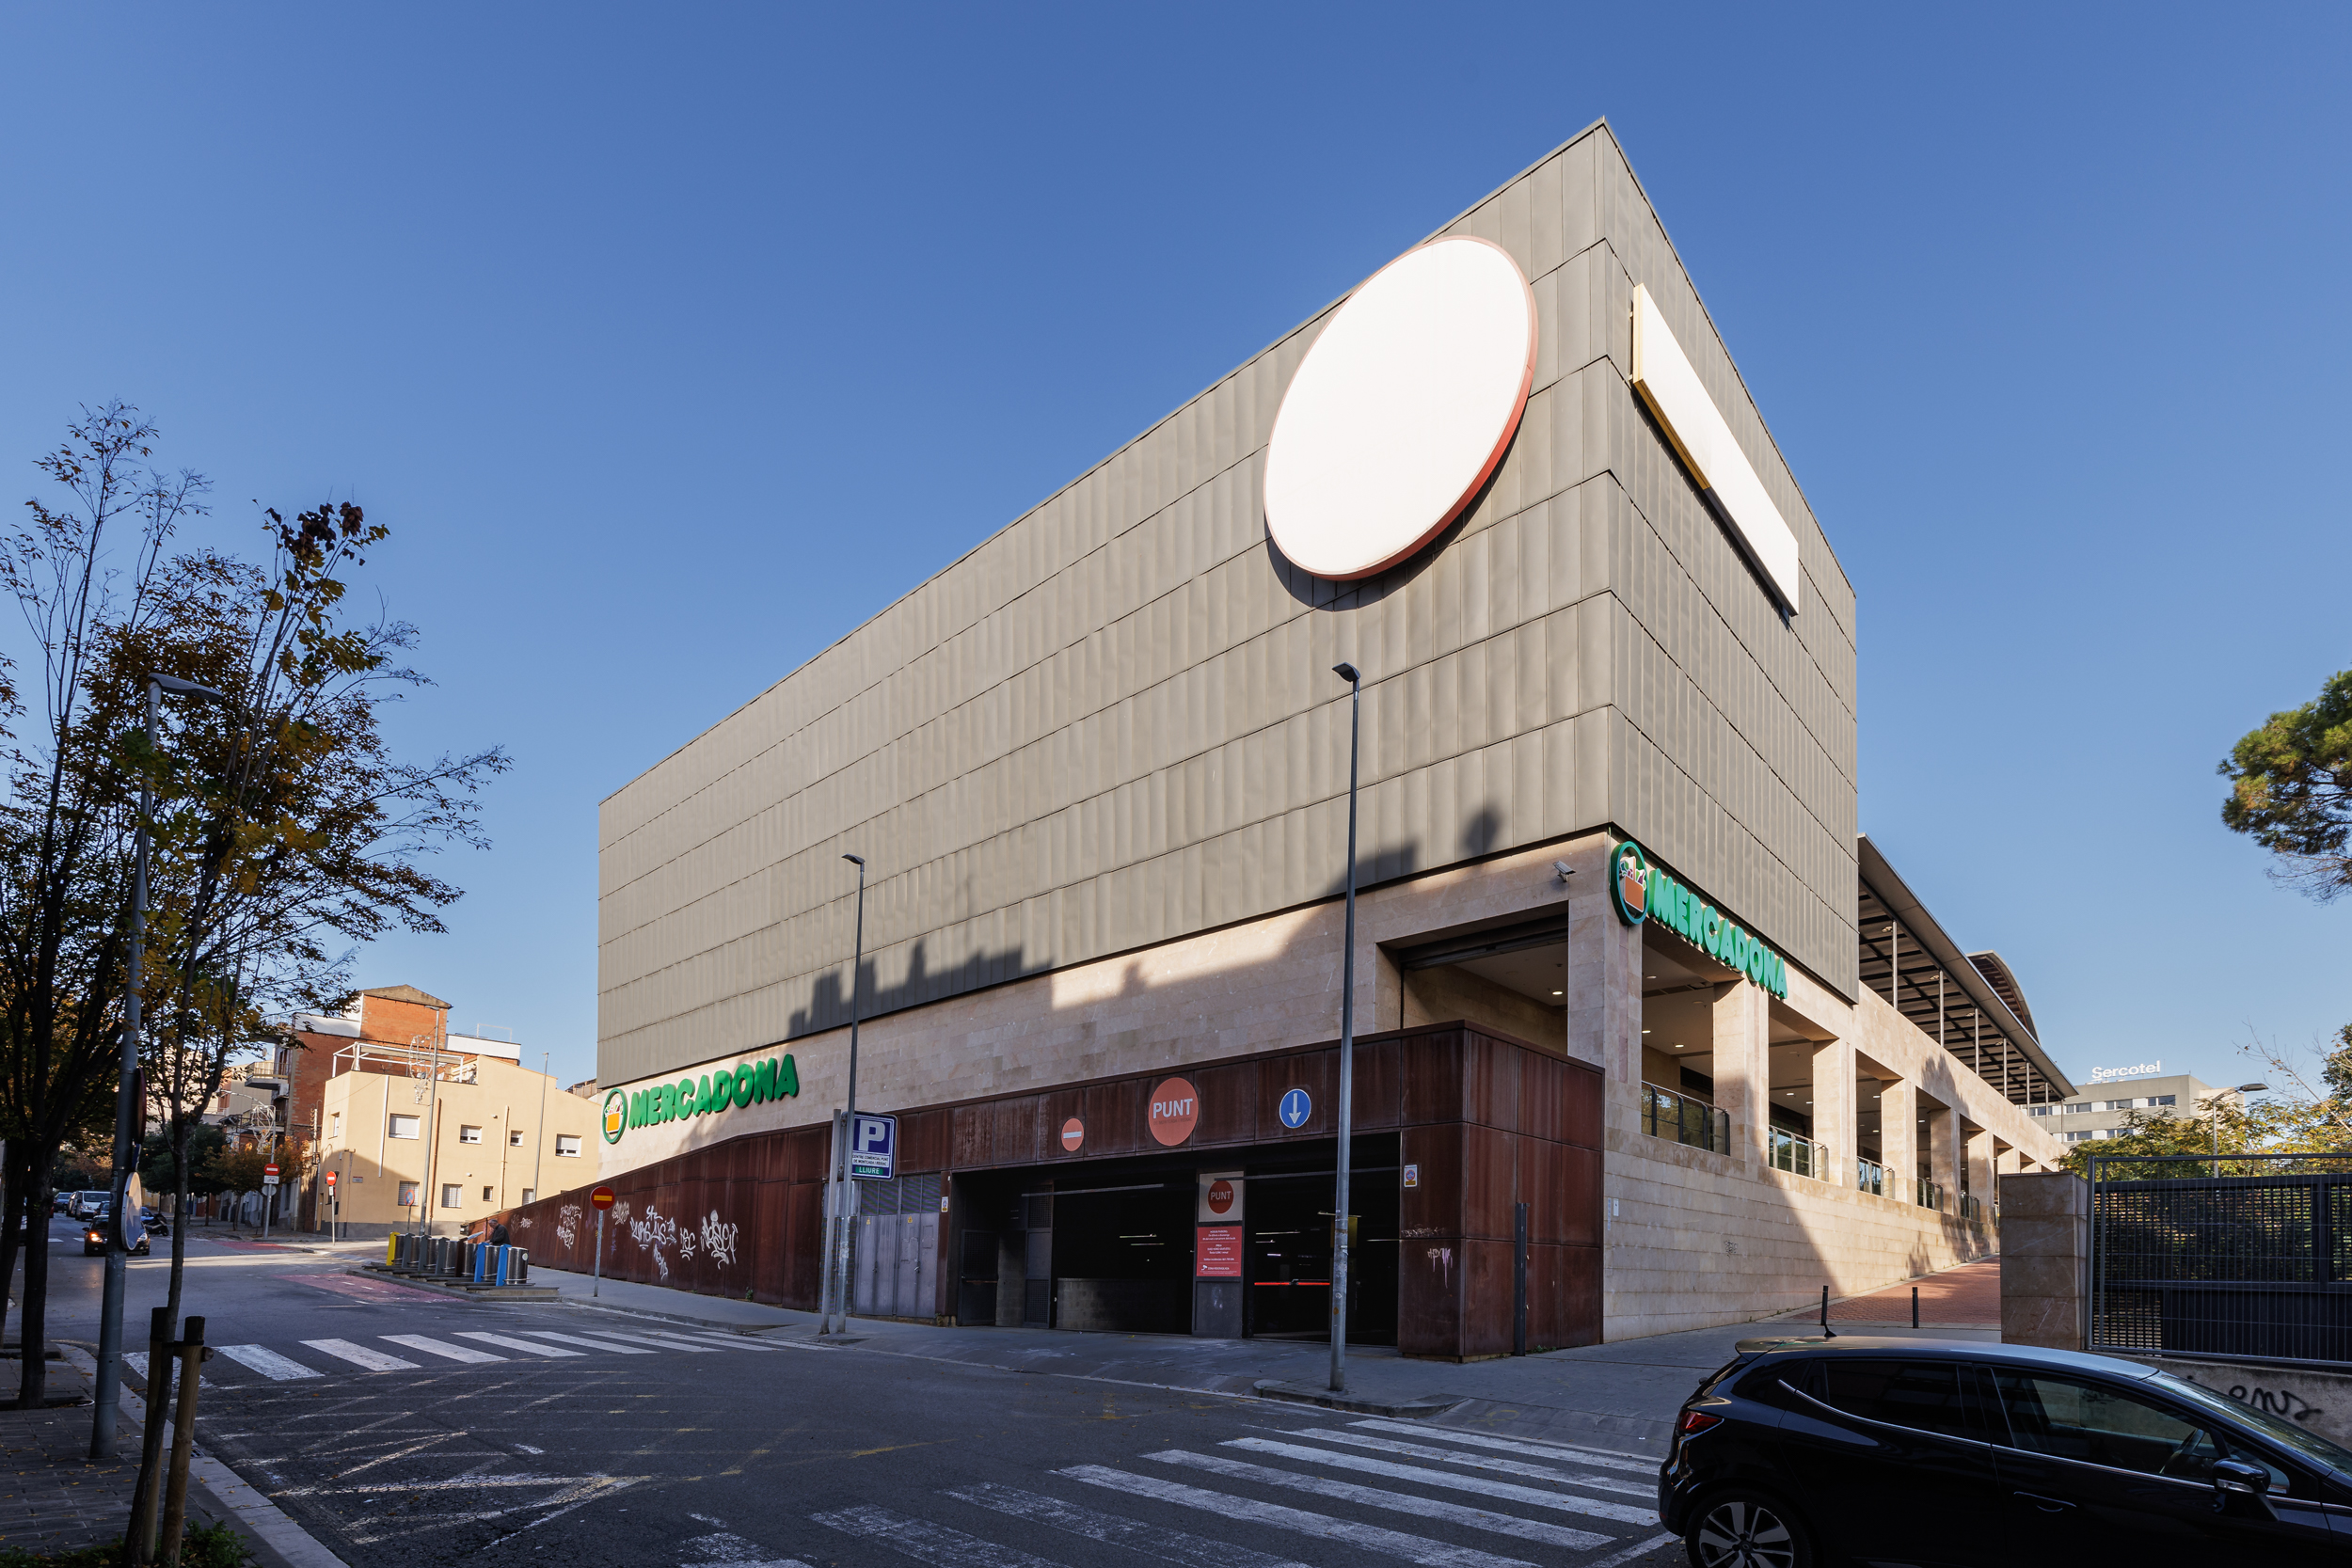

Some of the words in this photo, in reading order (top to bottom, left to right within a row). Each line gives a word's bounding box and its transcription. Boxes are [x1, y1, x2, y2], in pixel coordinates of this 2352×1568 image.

[1647, 868, 1788, 1000] MERCADONA
[2091, 1060, 2161, 1079] Sercotel
[628, 1053, 799, 1129] MERCADONA
[1153, 1098, 1193, 1118] PUNT
[859, 1119, 885, 1151] P
[1210, 1191, 1232, 1200] PUNT
